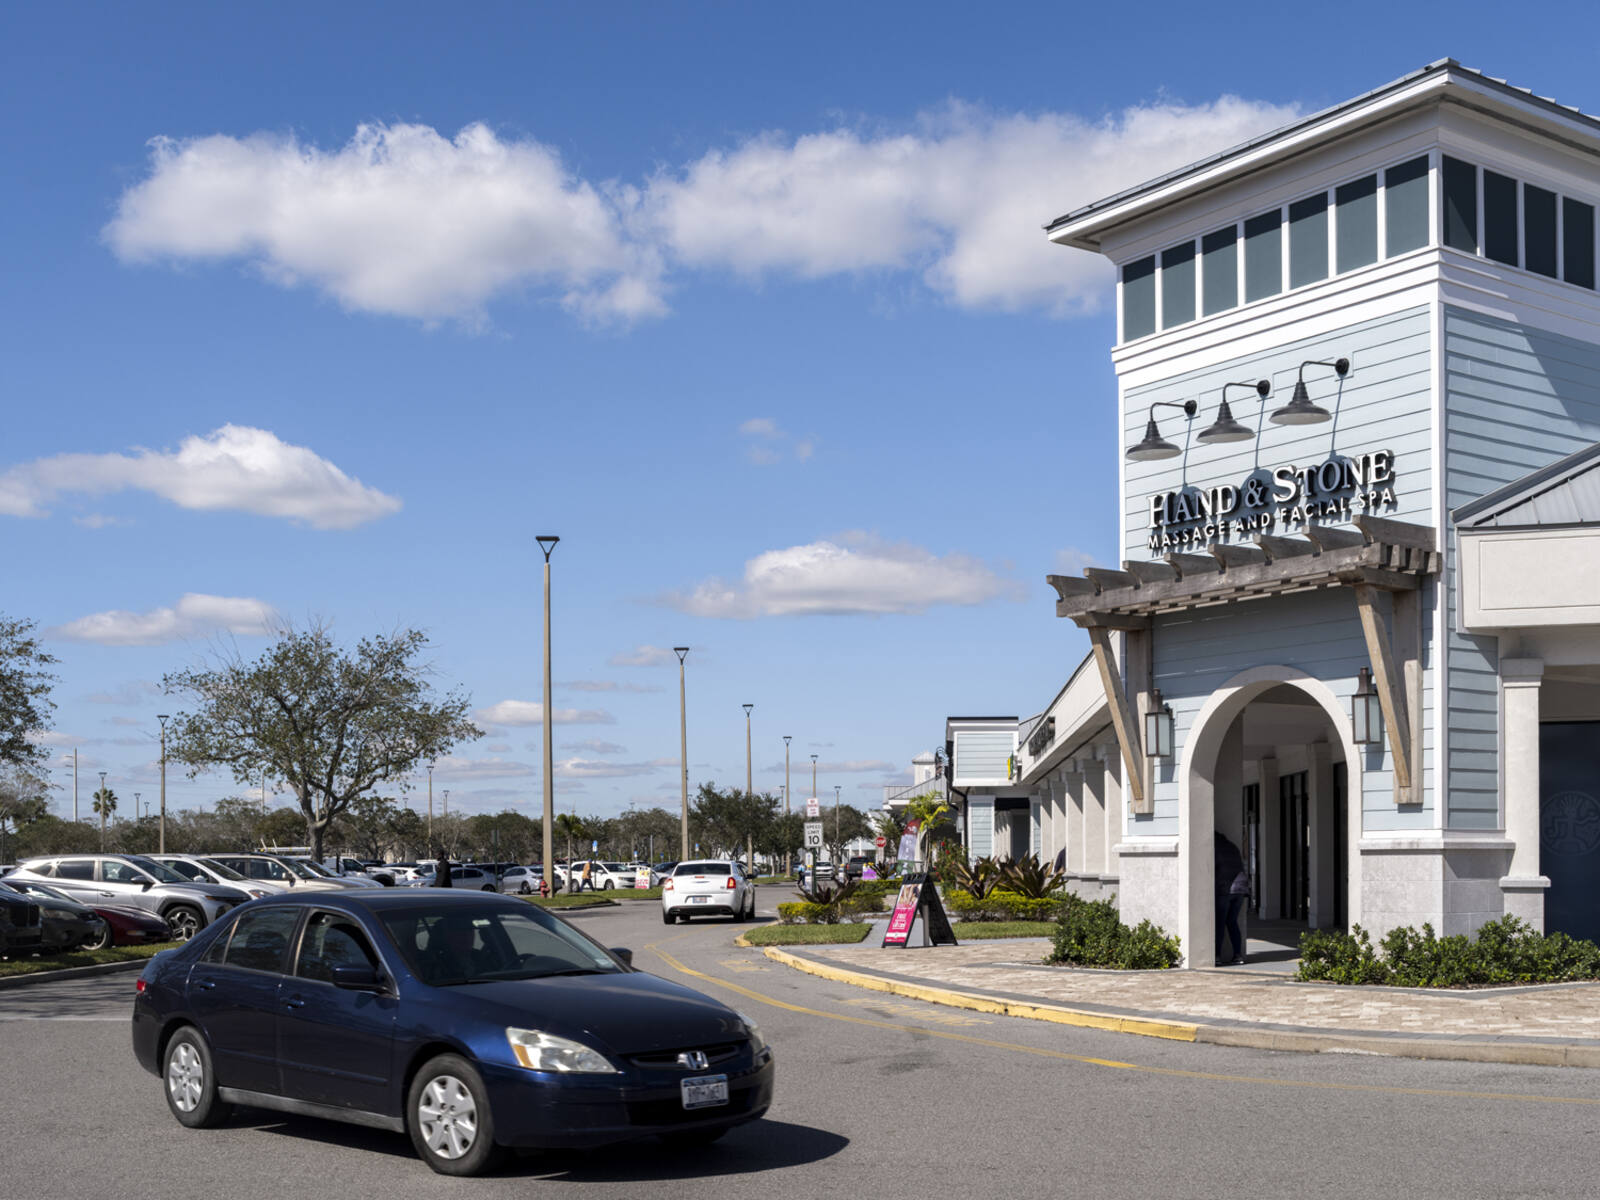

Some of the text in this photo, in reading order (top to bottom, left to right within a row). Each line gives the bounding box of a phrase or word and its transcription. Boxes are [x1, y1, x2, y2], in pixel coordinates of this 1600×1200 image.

[1147, 449, 1391, 529] HAND & STONE
[1148, 488, 1393, 549] MASSAGE AND FACIAL SPA
[808, 835, 820, 845] 10
